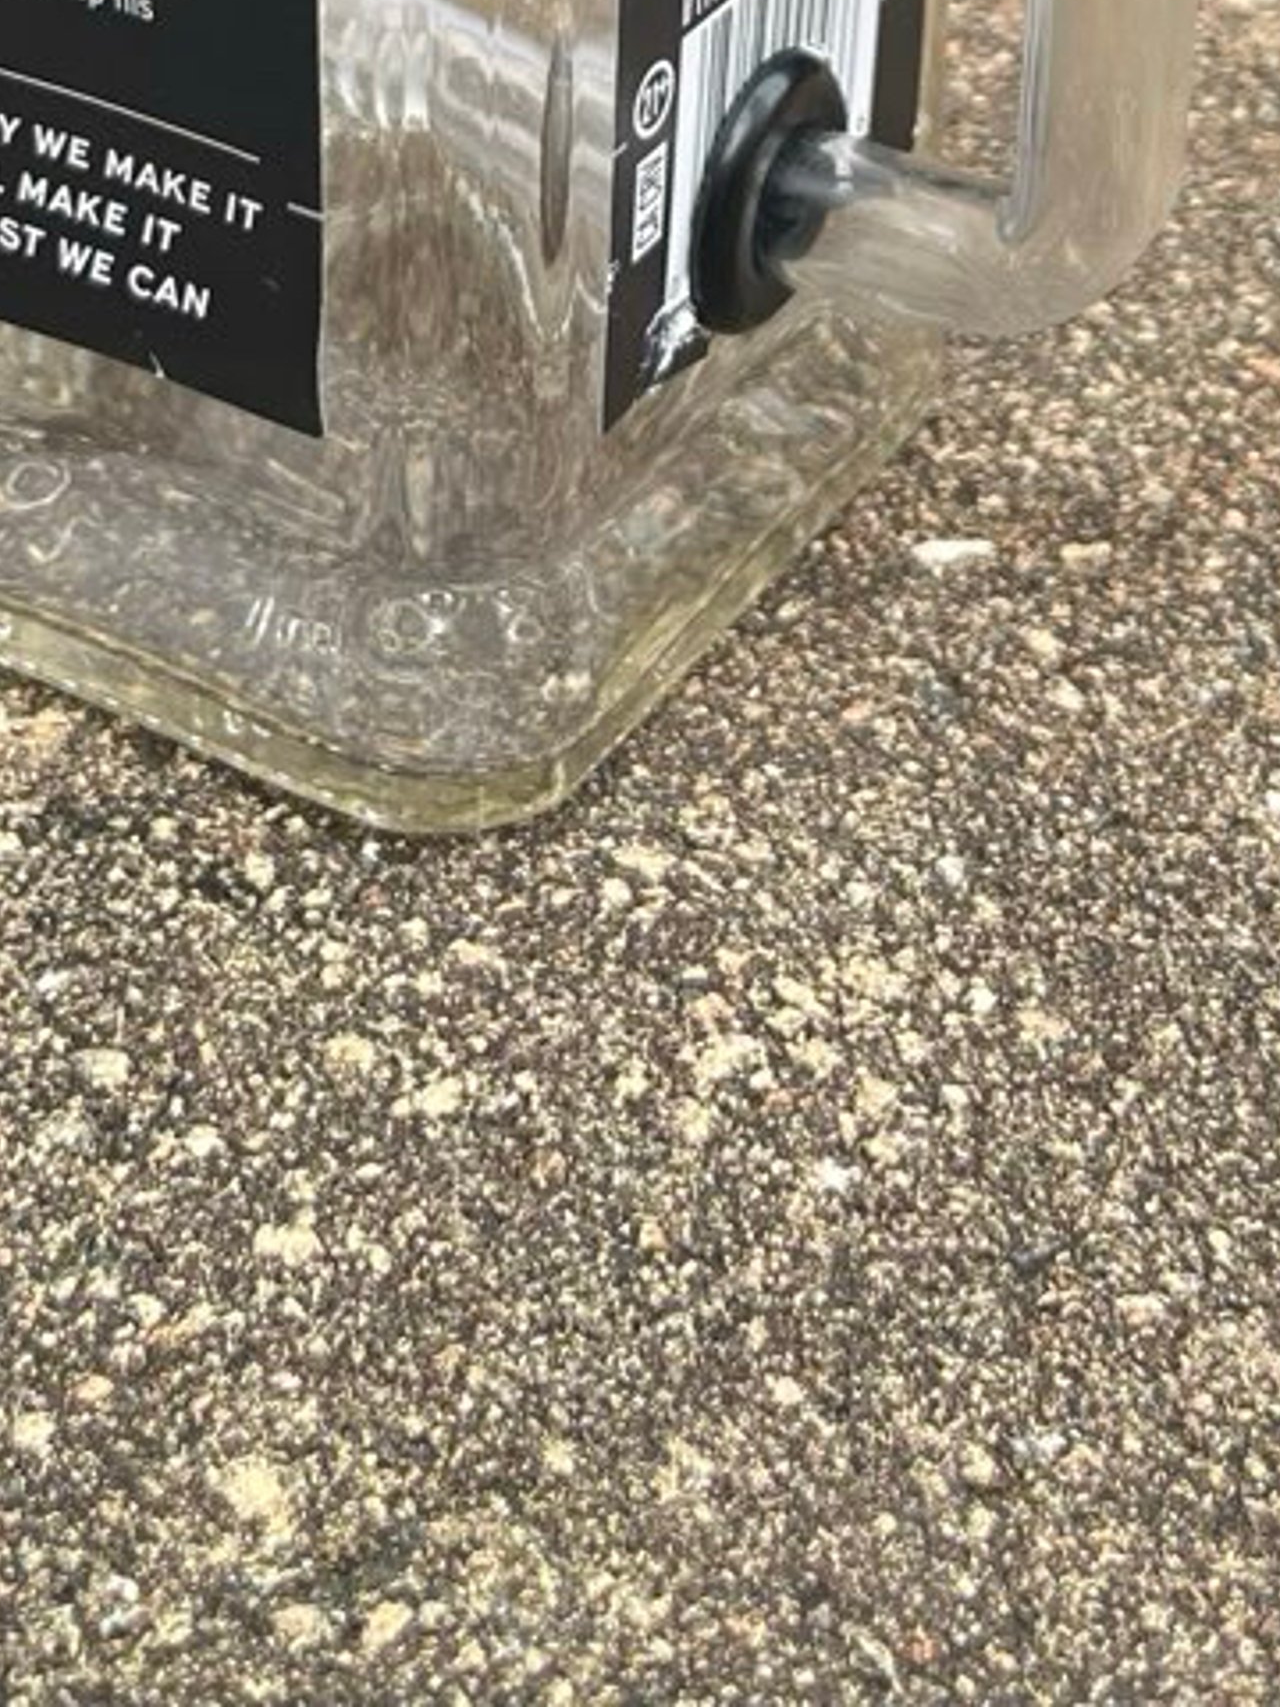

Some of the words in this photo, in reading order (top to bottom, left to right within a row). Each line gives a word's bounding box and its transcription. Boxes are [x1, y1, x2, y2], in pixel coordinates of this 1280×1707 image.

[18, 171, 126, 235] MAKE
[142, 213, 181, 252] IT
[34, 123, 90, 169] WE
[104, 149, 211, 215] MAKE
[226, 192, 263, 231] IT
[58, 235, 114, 285] WE
[128, 265, 210, 319] CAN
